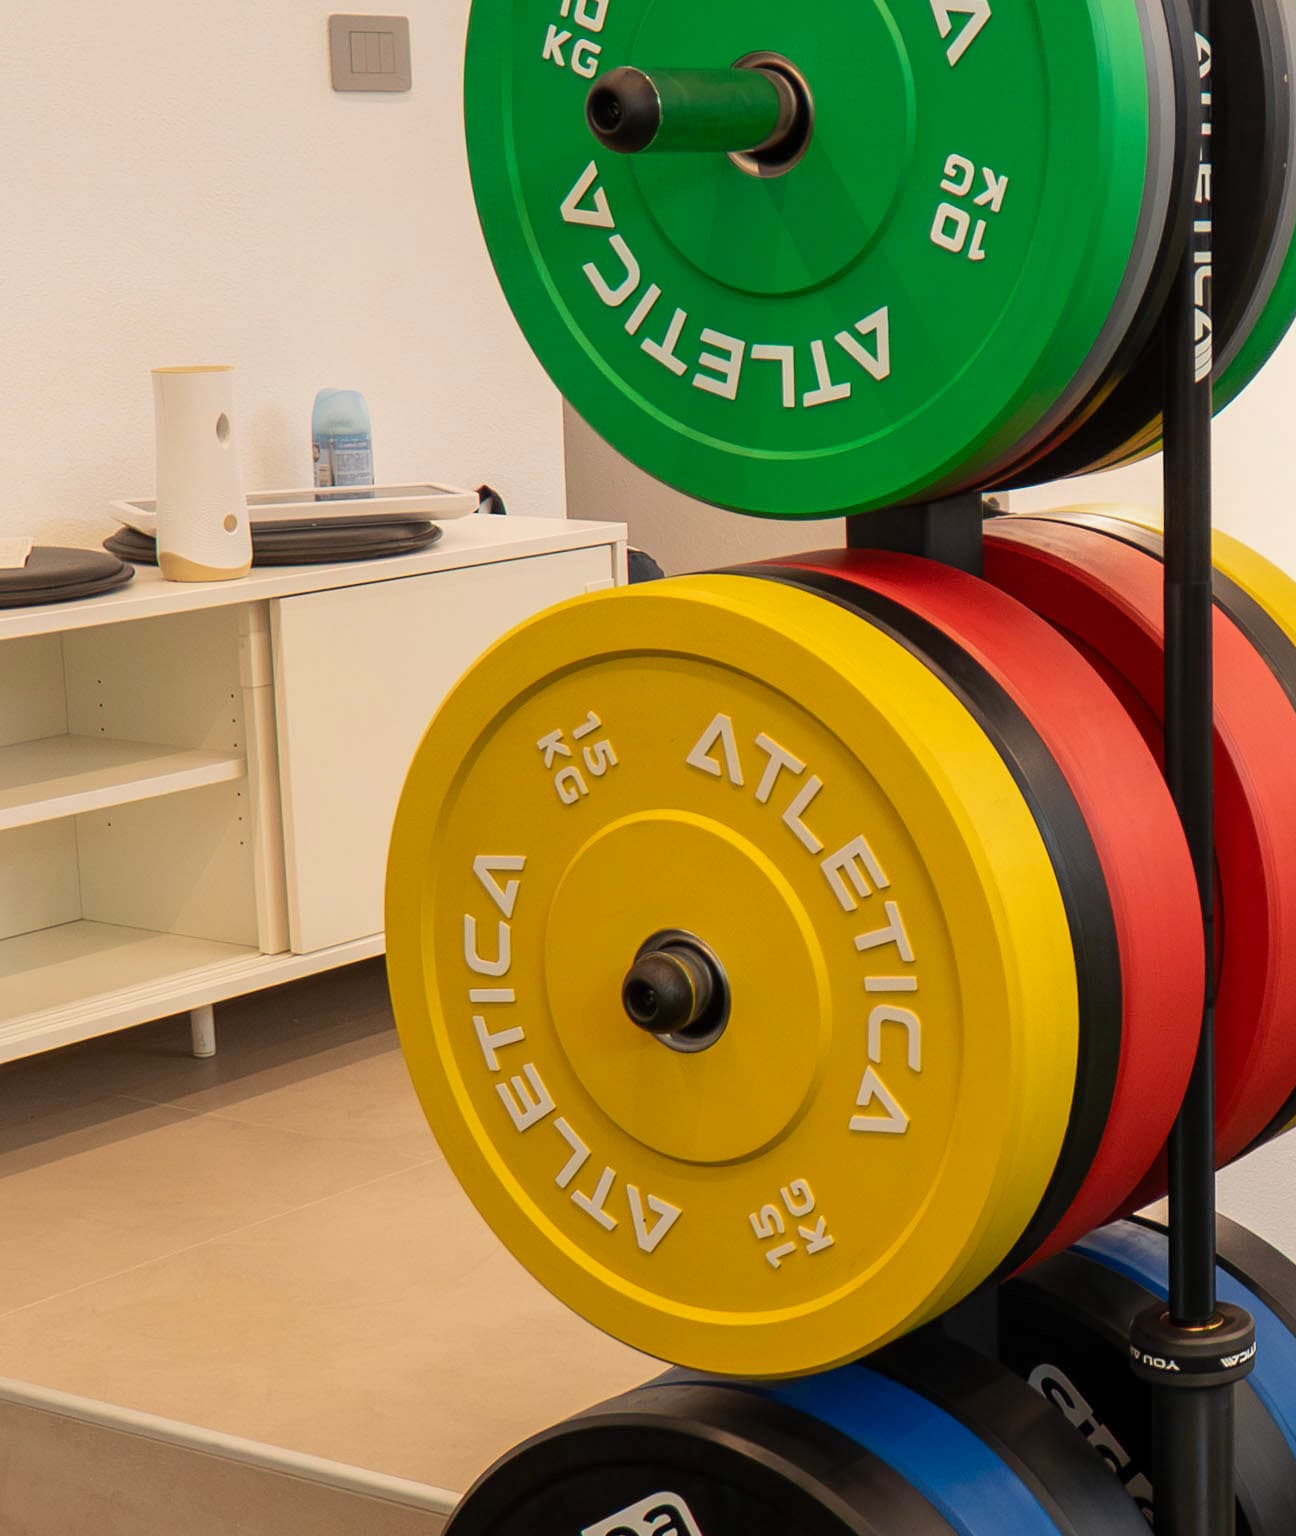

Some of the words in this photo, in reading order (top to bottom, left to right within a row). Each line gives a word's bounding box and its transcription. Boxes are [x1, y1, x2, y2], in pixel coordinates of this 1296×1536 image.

[541, 23, 600, 79] KG
[939, 154, 1009, 213] KG
[930, 202, 987, 262] 10
[559, 159, 892, 410] ATLETICA
[536, 727, 590, 807] KG
[572, 710, 618, 779] 15
[685, 713, 922, 1136] ATLETICA
[461, 853, 682, 1255] ATLETICA
[748, 1204, 798, 1271] 15
[780, 1177, 836, 1258] KG
